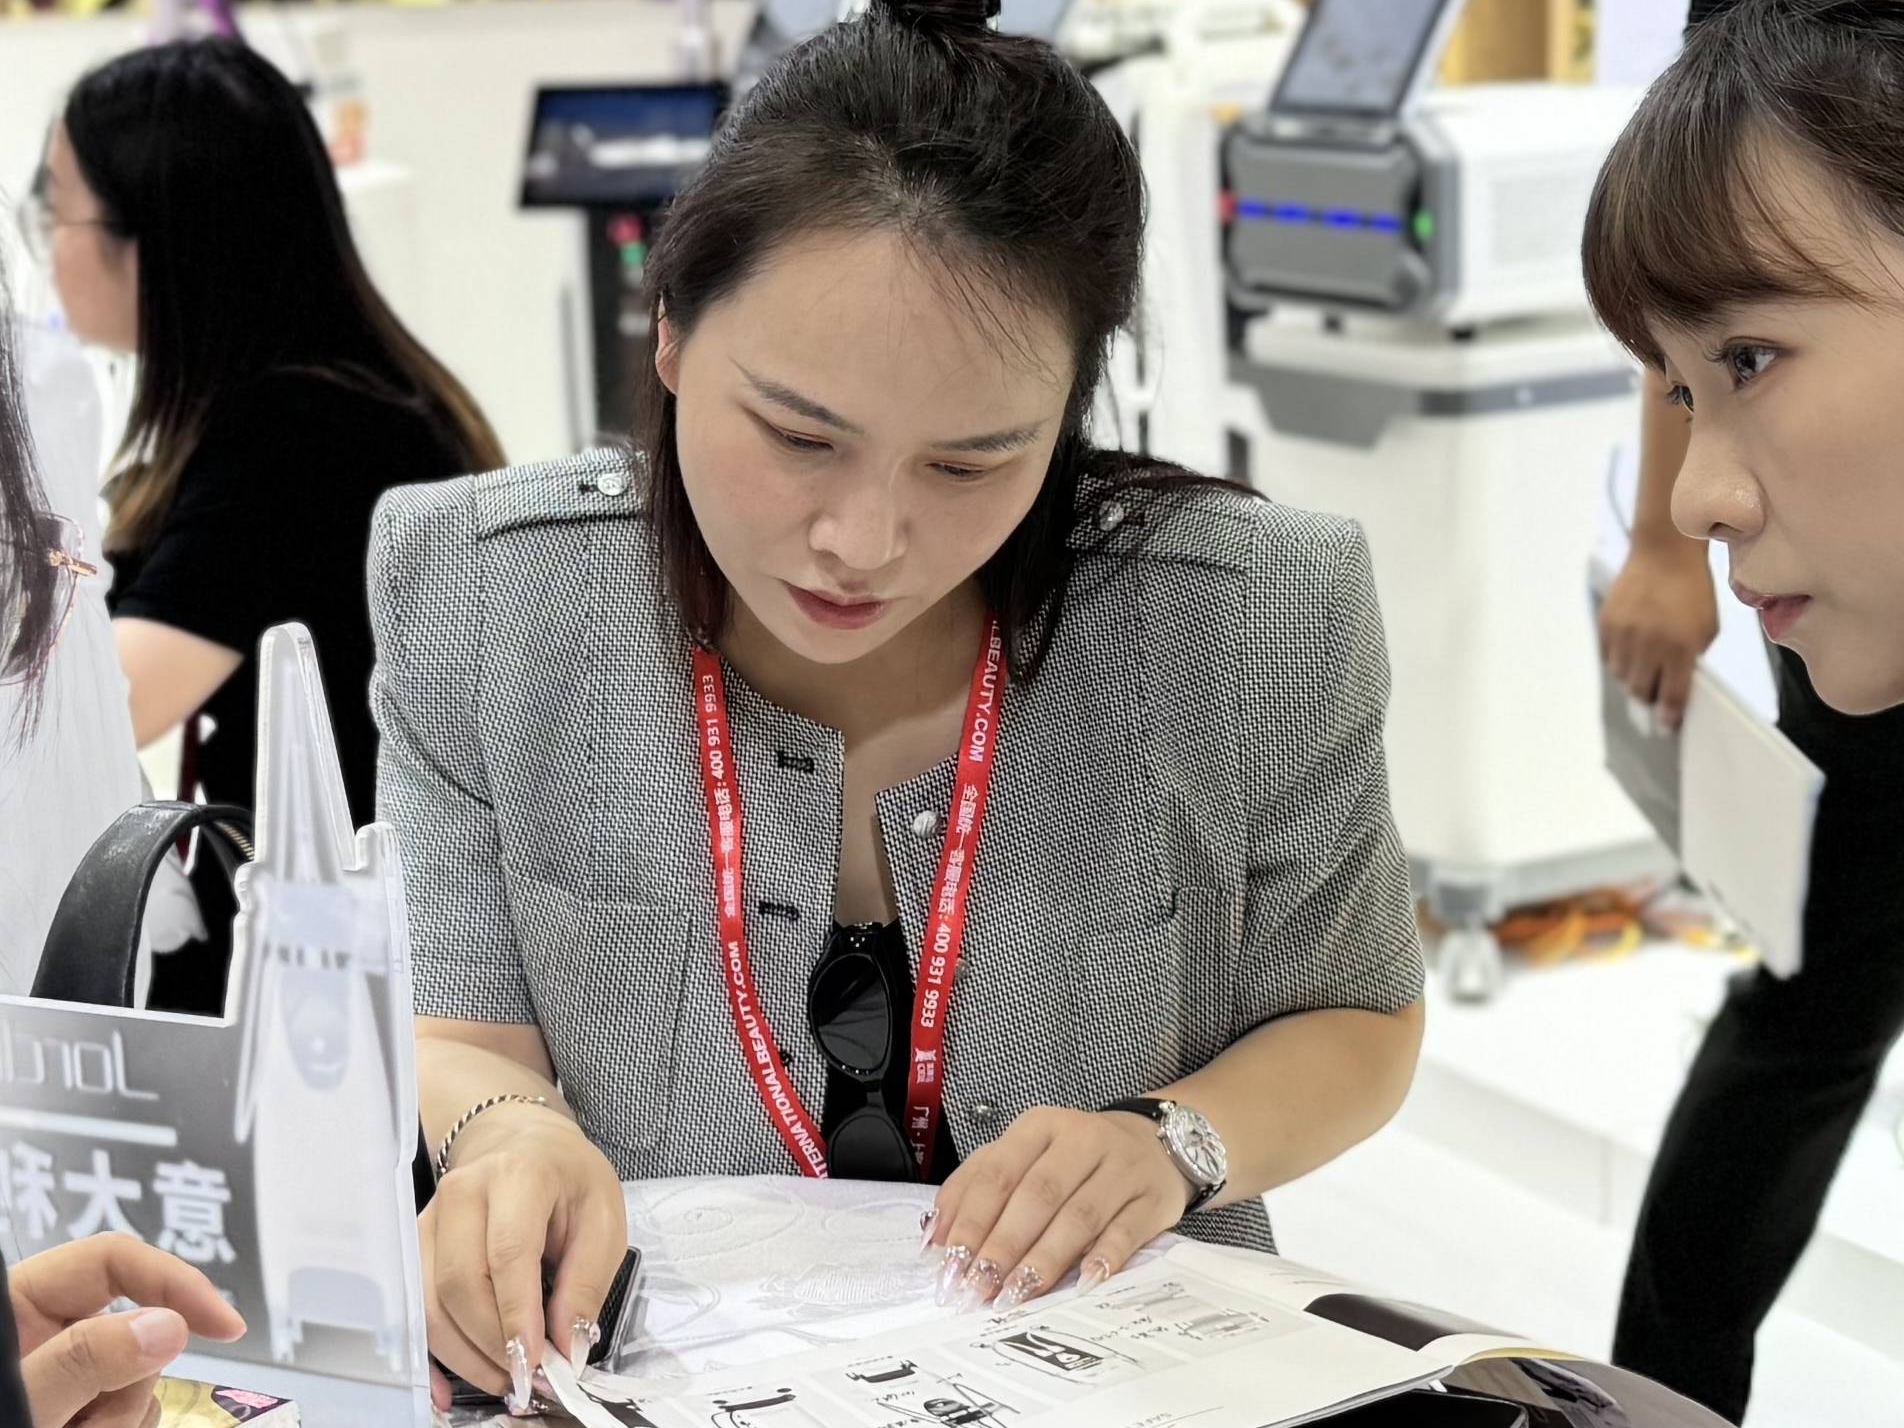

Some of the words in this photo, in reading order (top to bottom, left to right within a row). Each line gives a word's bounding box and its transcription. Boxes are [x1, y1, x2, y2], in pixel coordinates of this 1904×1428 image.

[702, 673, 718, 714] 9933
[968, 619, 1002, 762] BEAUTY.COM
[706, 718, 720, 747] 931
[927, 956, 946, 985] 931
[920, 988, 940, 1028] 9933
